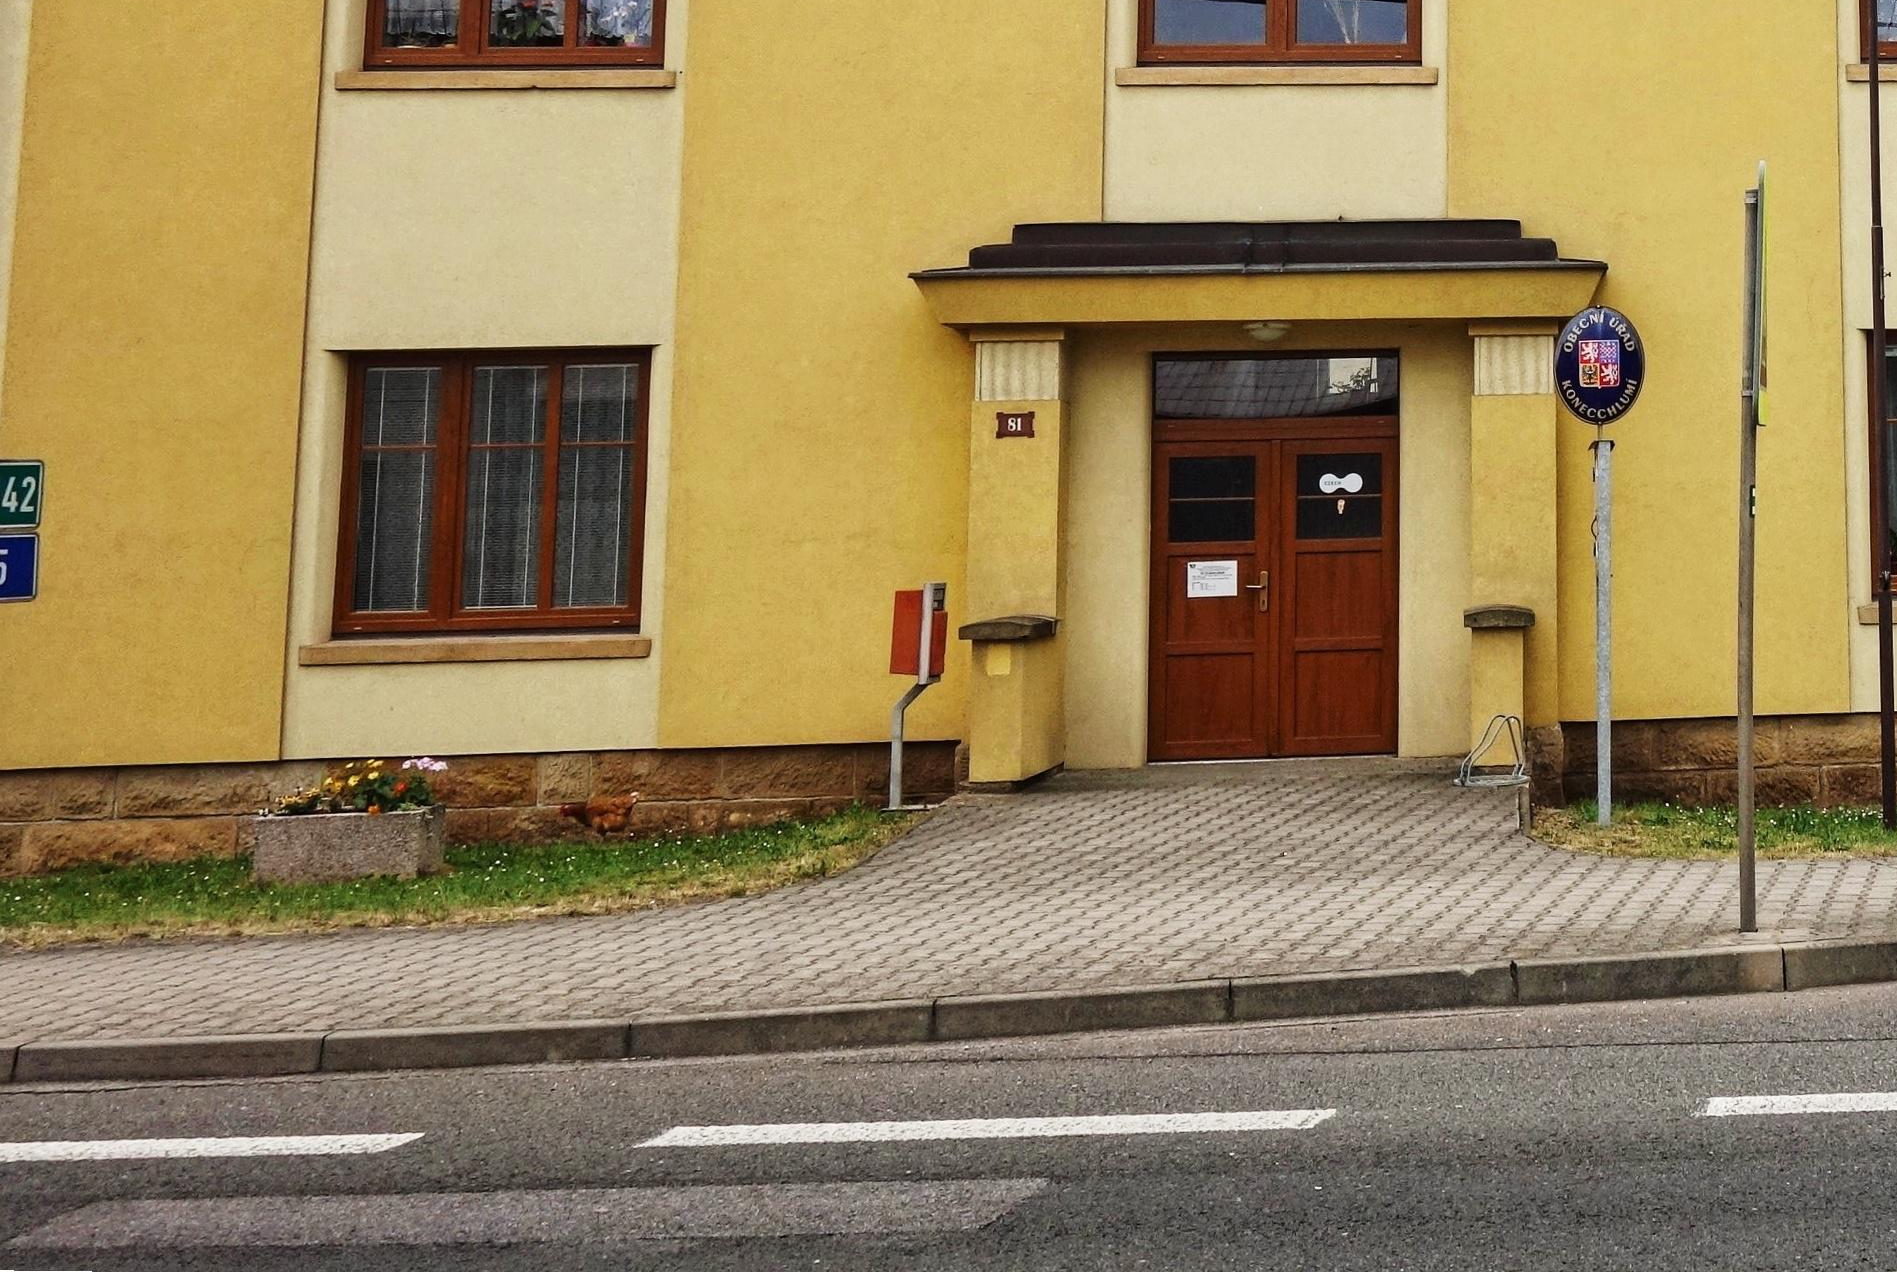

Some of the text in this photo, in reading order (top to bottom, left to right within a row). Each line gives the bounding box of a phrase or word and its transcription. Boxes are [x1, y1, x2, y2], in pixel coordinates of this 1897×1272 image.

[1563, 309, 1635, 353] OBECNÍ ÚŘAD
[1561, 377, 1638, 419] KONECCHLUMÍ
[1007, 417, 1021, 432] 81
[1, 475, 37, 513] 42
